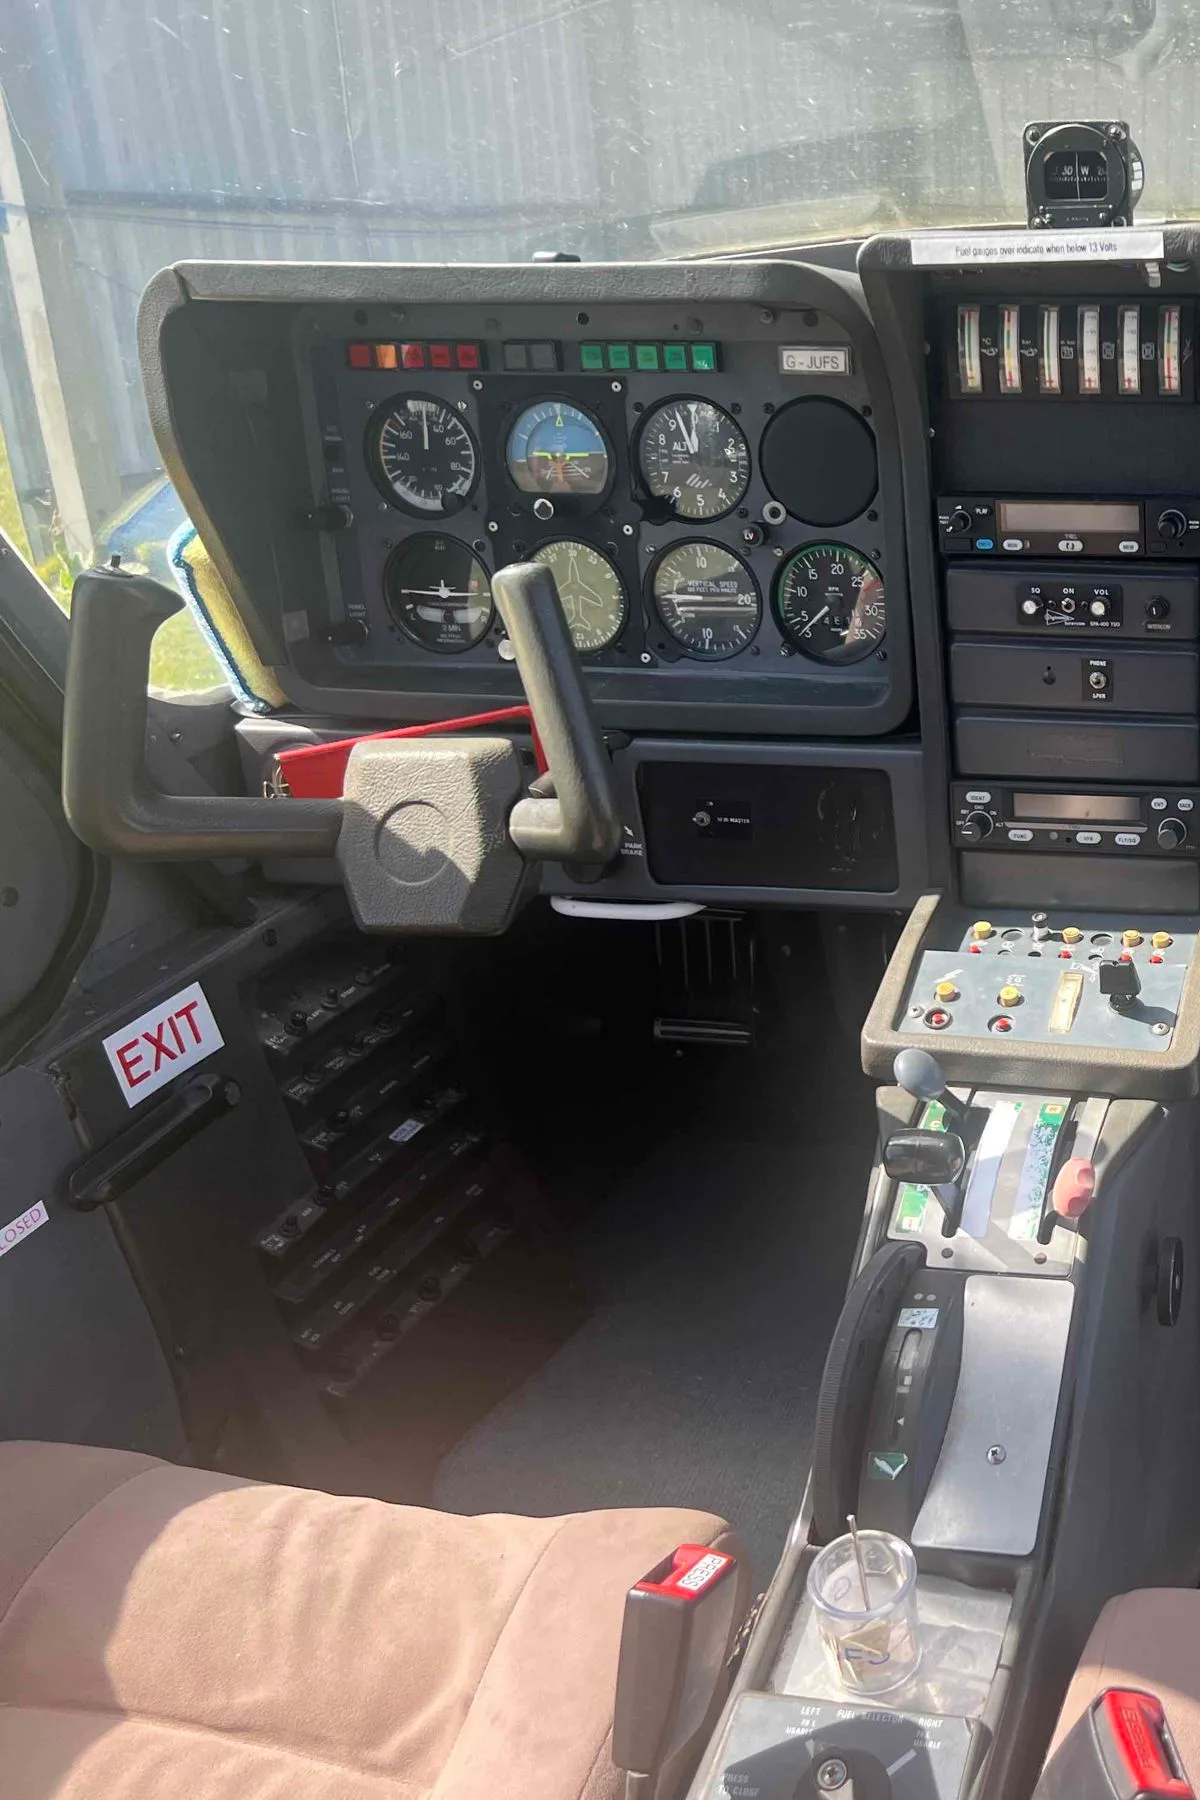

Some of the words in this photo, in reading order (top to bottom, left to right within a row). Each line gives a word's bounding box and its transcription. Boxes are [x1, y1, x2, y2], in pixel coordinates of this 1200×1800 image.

[1080, 165, 1090, 176] W
[956, 246, 971, 256] Fuel
[972, 247, 998, 257] gauges
[1000, 247, 1015, 255] over
[1016, 245, 1044, 255] indicate
[1046, 243, 1064, 253] when
[1066, 243, 1087, 253] below
[1089, 242, 1098, 252] 13
[1099, 242, 1118, 252] Volts
[433, 424, 444, 433] 40
[668, 419, 677, 431] 9
[445, 437, 456, 445] 60
[659, 433, 666, 445] 8
[728, 438, 735, 449] 2
[662, 471, 669, 483] 7
[730, 471, 738, 483] 3
[673, 486, 681, 498] 6
[718, 488, 727, 499] 4
[696, 494, 705, 506] 5
[696, 556, 707, 569] 10
[808, 568, 818, 580] 15
[830, 563, 844, 575] 20
[851, 576, 864, 588] 25
[797, 586, 808, 598] 10
[738, 593, 752, 605] 20
[801, 610, 809, 622] 5
[865, 605, 878, 616] 30
[702, 628, 713, 639] 10
[853, 629, 867, 640] 35
[116, 1000, 202, 1089] EXIT
[681, 1557, 723, 1587] PRESS
[800, 1706, 822, 1716] LEFT
[836, 1710, 856, 1720] FUEL
[860, 1711, 906, 1724] SELECTOR
[917, 1717, 944, 1729] RIGHT
[722, 1772, 750, 1783] PRESS
[732, 1785, 760, 1797] CLOSE
